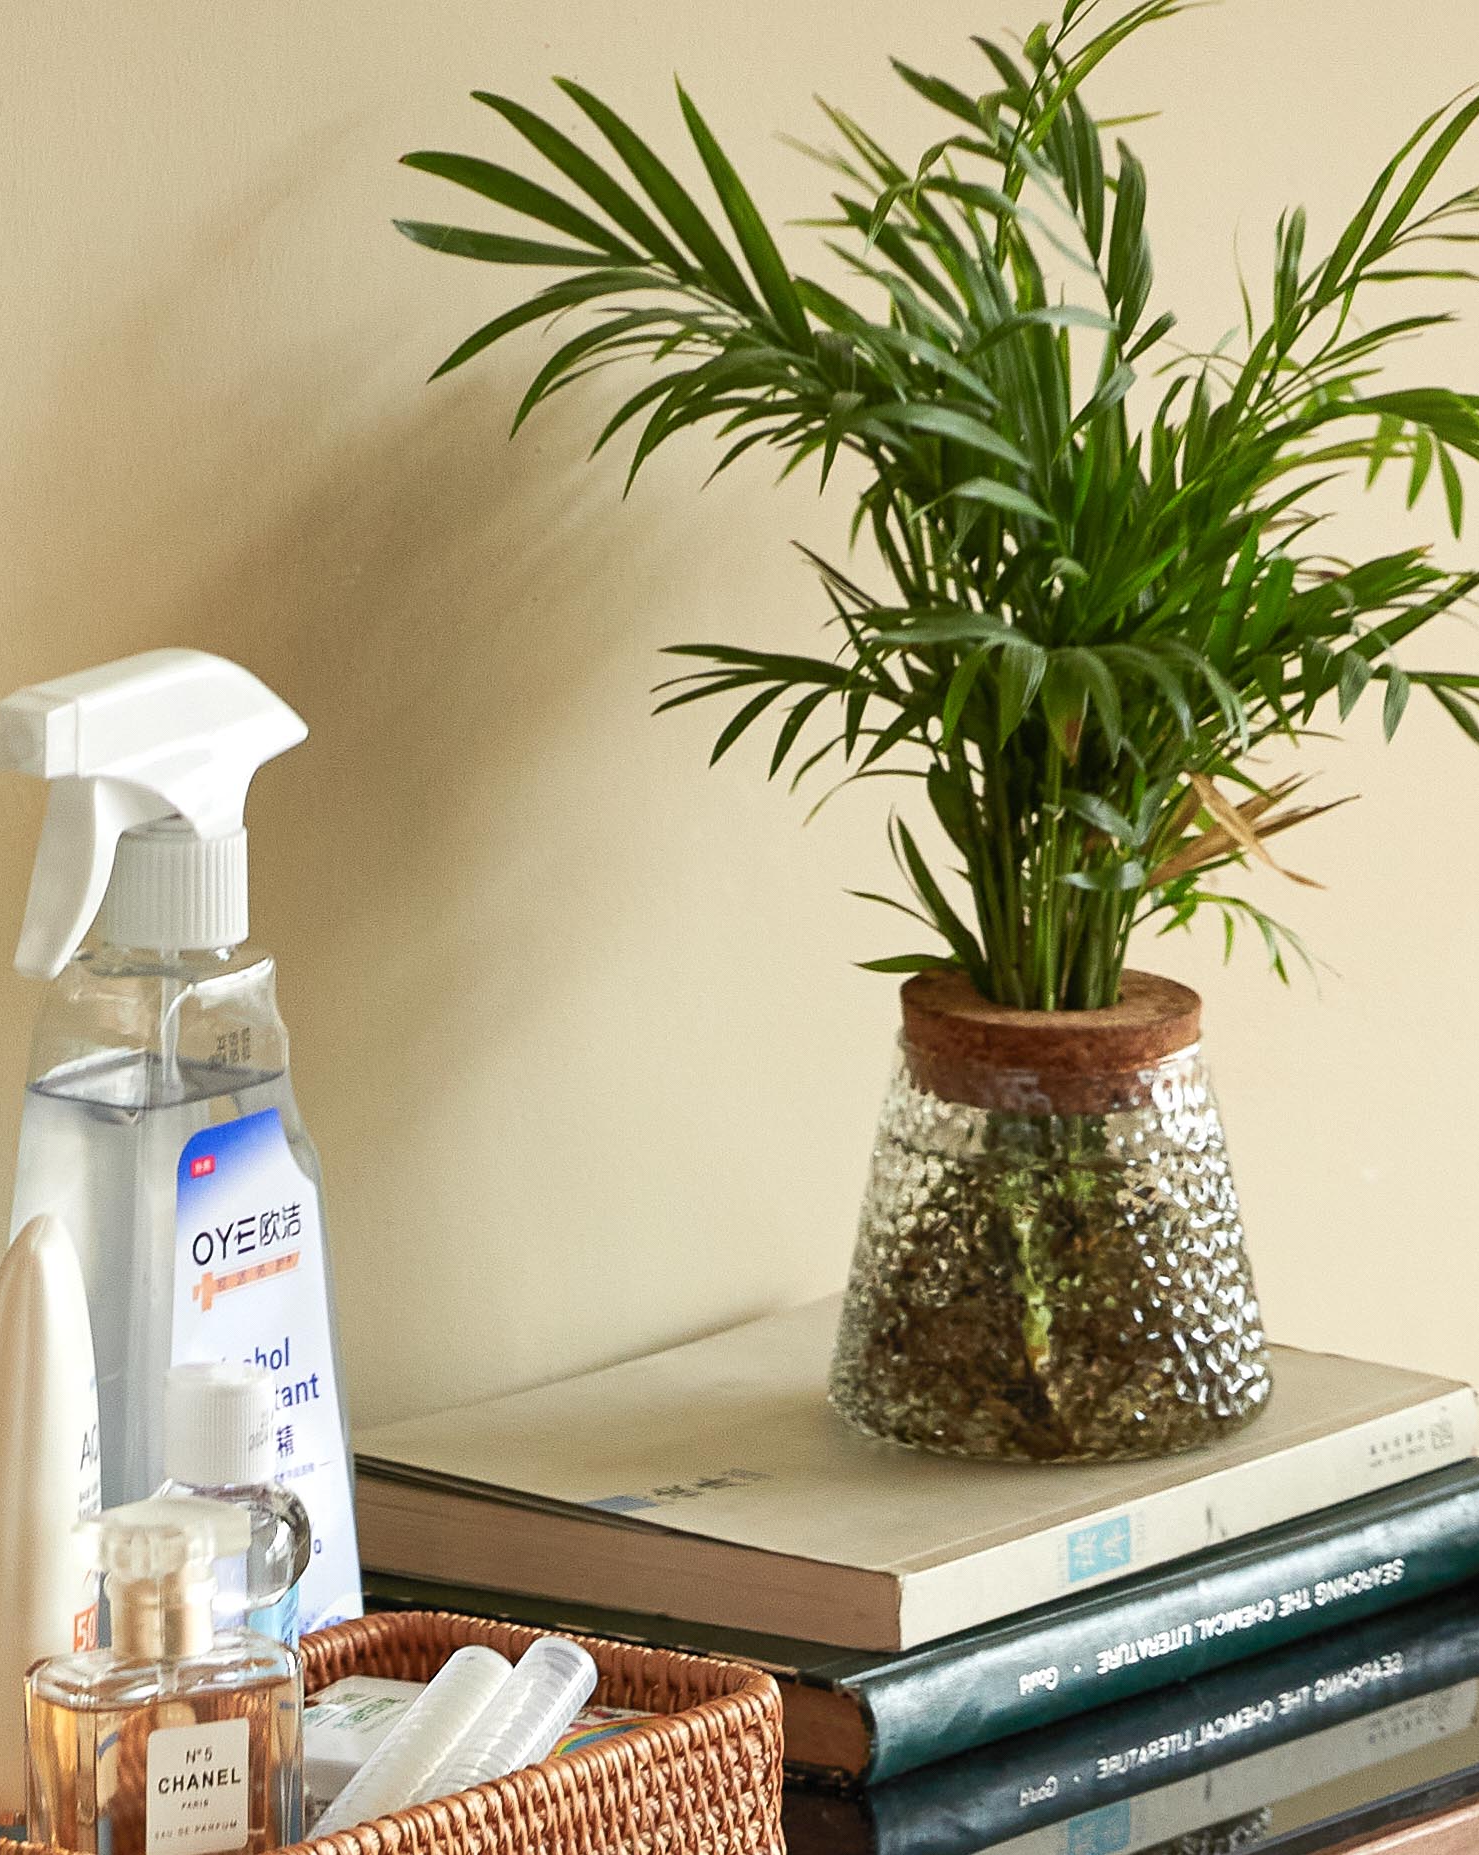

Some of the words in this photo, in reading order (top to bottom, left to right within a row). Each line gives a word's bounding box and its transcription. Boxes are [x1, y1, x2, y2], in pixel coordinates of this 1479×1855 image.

[1314, 1558, 1406, 1605] SEARCHING
[1193, 1597, 1276, 1641] CHEMICAL
[1277, 1587, 1312, 1616] THE
[1095, 1624, 1194, 1674] LITERATURE
[158, 1767, 242, 1794] CHANEL
[194, 1819, 238, 1836] PARFUM
